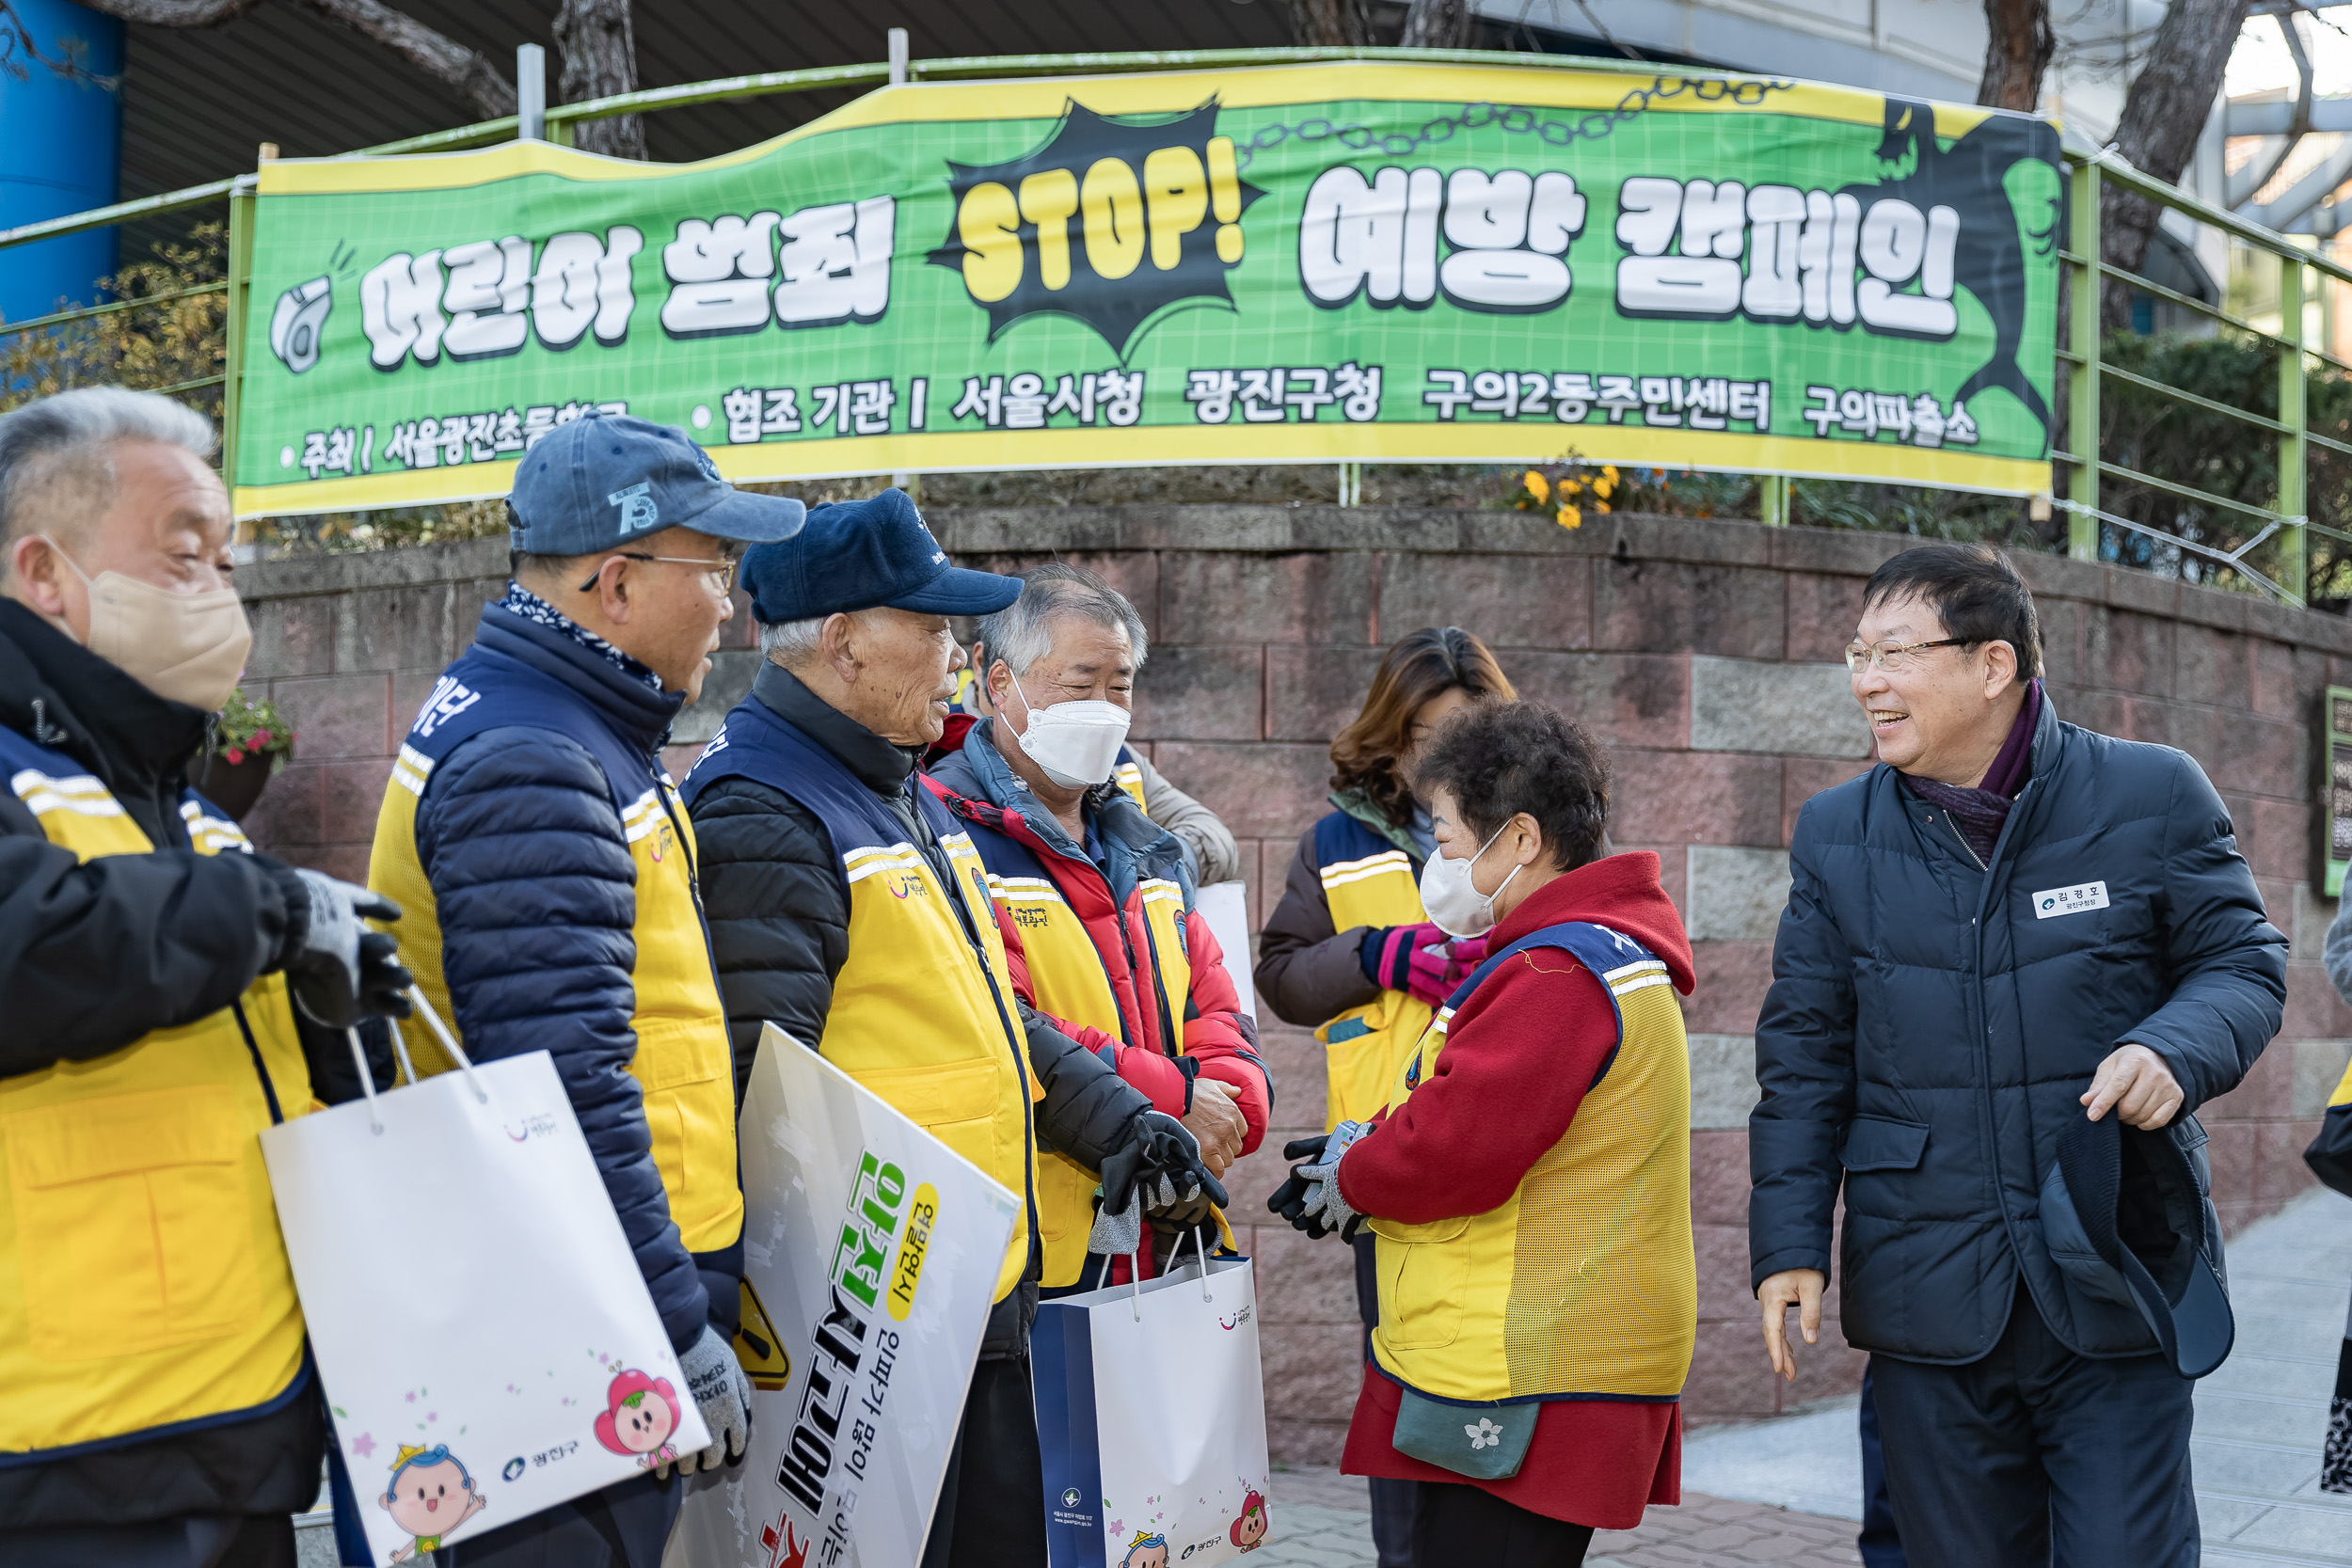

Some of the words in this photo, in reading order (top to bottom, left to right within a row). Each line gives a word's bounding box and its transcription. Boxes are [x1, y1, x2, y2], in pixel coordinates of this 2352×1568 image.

[360, 225, 644, 369] 어린이
[660, 194, 896, 339] 범죄
[957, 136, 1245, 302] STOP!
[1299, 166, 1586, 314] 예방
[1614, 176, 1961, 342] 캠페인
[301, 426, 355, 480] 주최
[384, 402, 628, 469] 서울광진초등
[723, 384, 802, 444] 협조
[811, 378, 896, 437] 기관
[950, 367, 1146, 428] 서울시청
[1184, 361, 1383, 424] 광진구청
[1424, 369, 1771, 433] 구의2동주민센터
[1803, 385, 1979, 448] 구의파출소
[2066, 898, 2096, 910] 광진구청장
[892, 1202, 933, 1304] 연말연시
[775, 1149, 908, 1519] 안전사고에
[861, 1327, 900, 1417] 인파가
[532, 1440, 580, 1467] 광진구
[844, 1418, 876, 1482] 많이
[1197, 1536, 1222, 1552] 광진구
